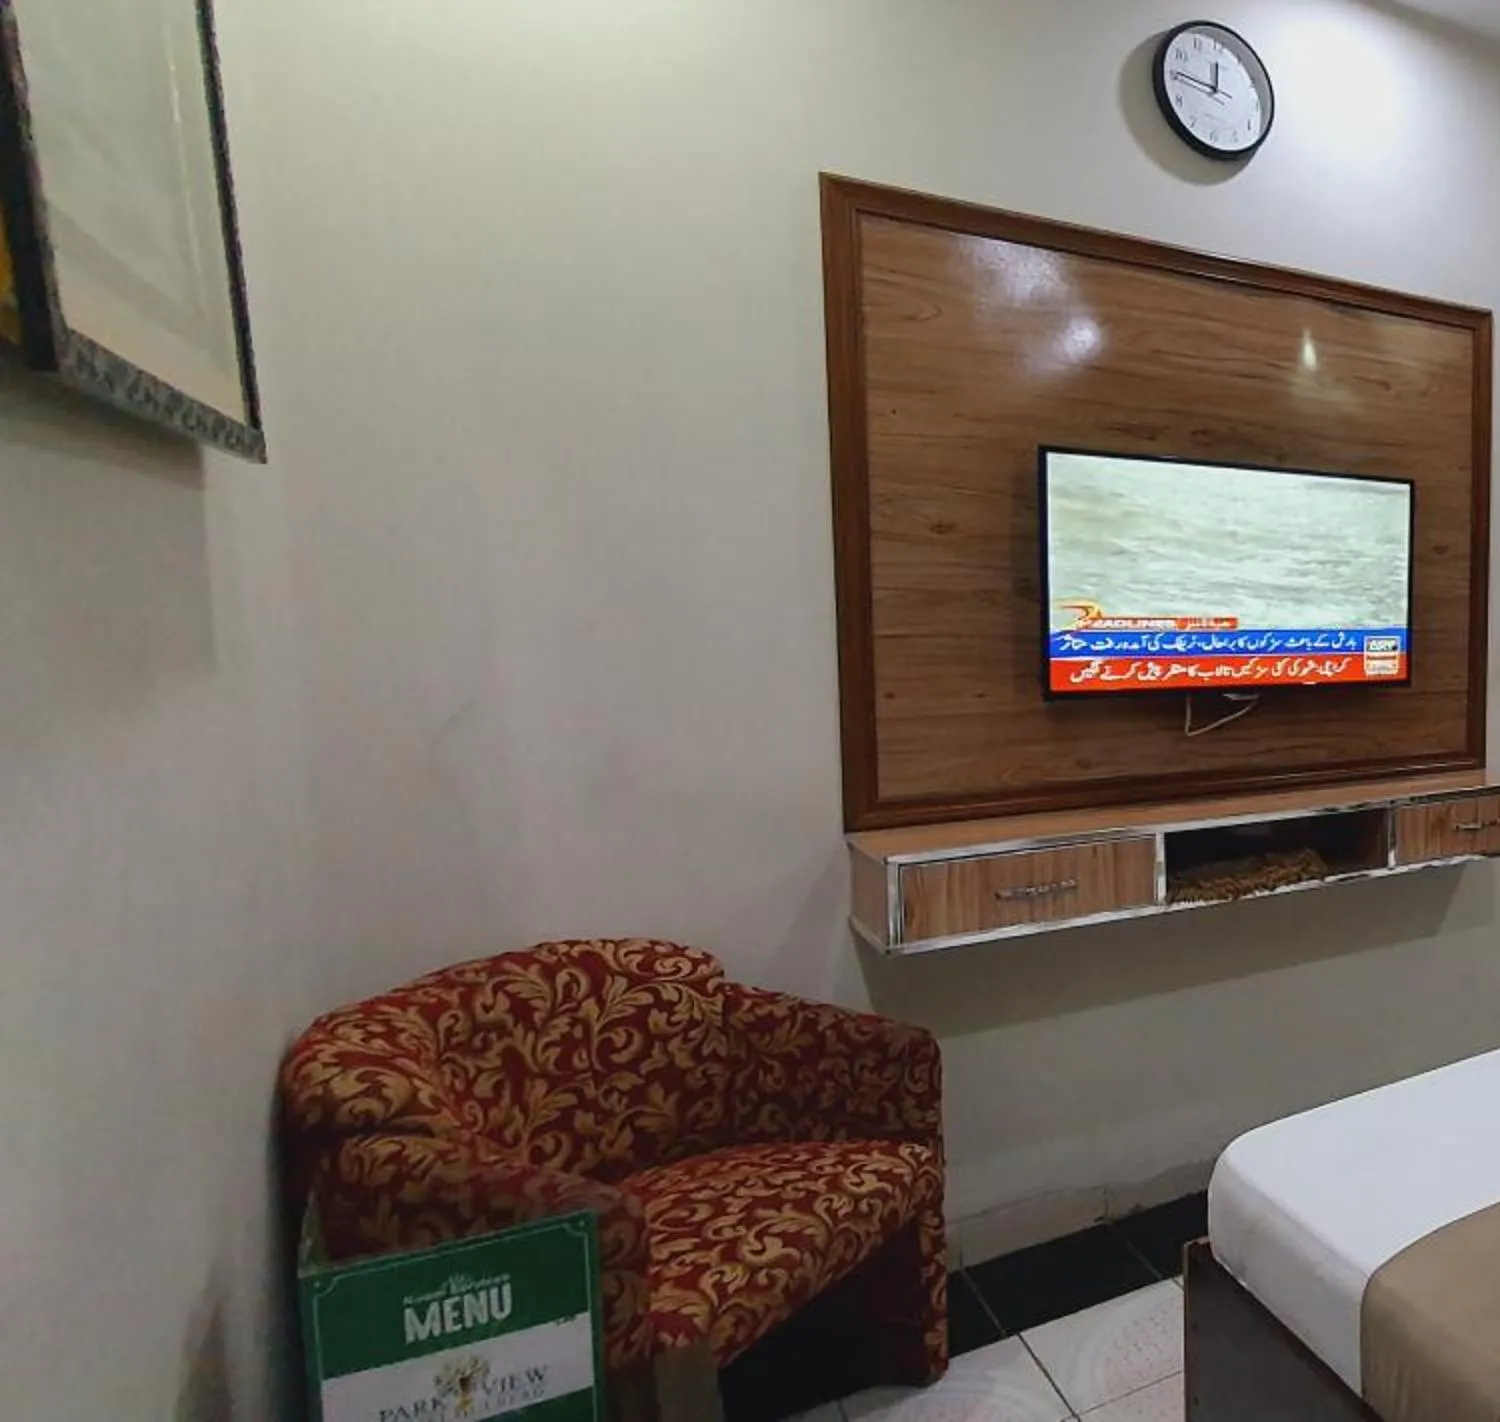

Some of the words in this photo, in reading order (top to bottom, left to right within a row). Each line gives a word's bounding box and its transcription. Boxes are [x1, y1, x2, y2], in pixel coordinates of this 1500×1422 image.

[1313, 633, 1330, 647] کے
[404, 1282, 512, 1345] MENU
[379, 1396, 446, 1422] PARK
[482, 1364, 549, 1396] VIEW
